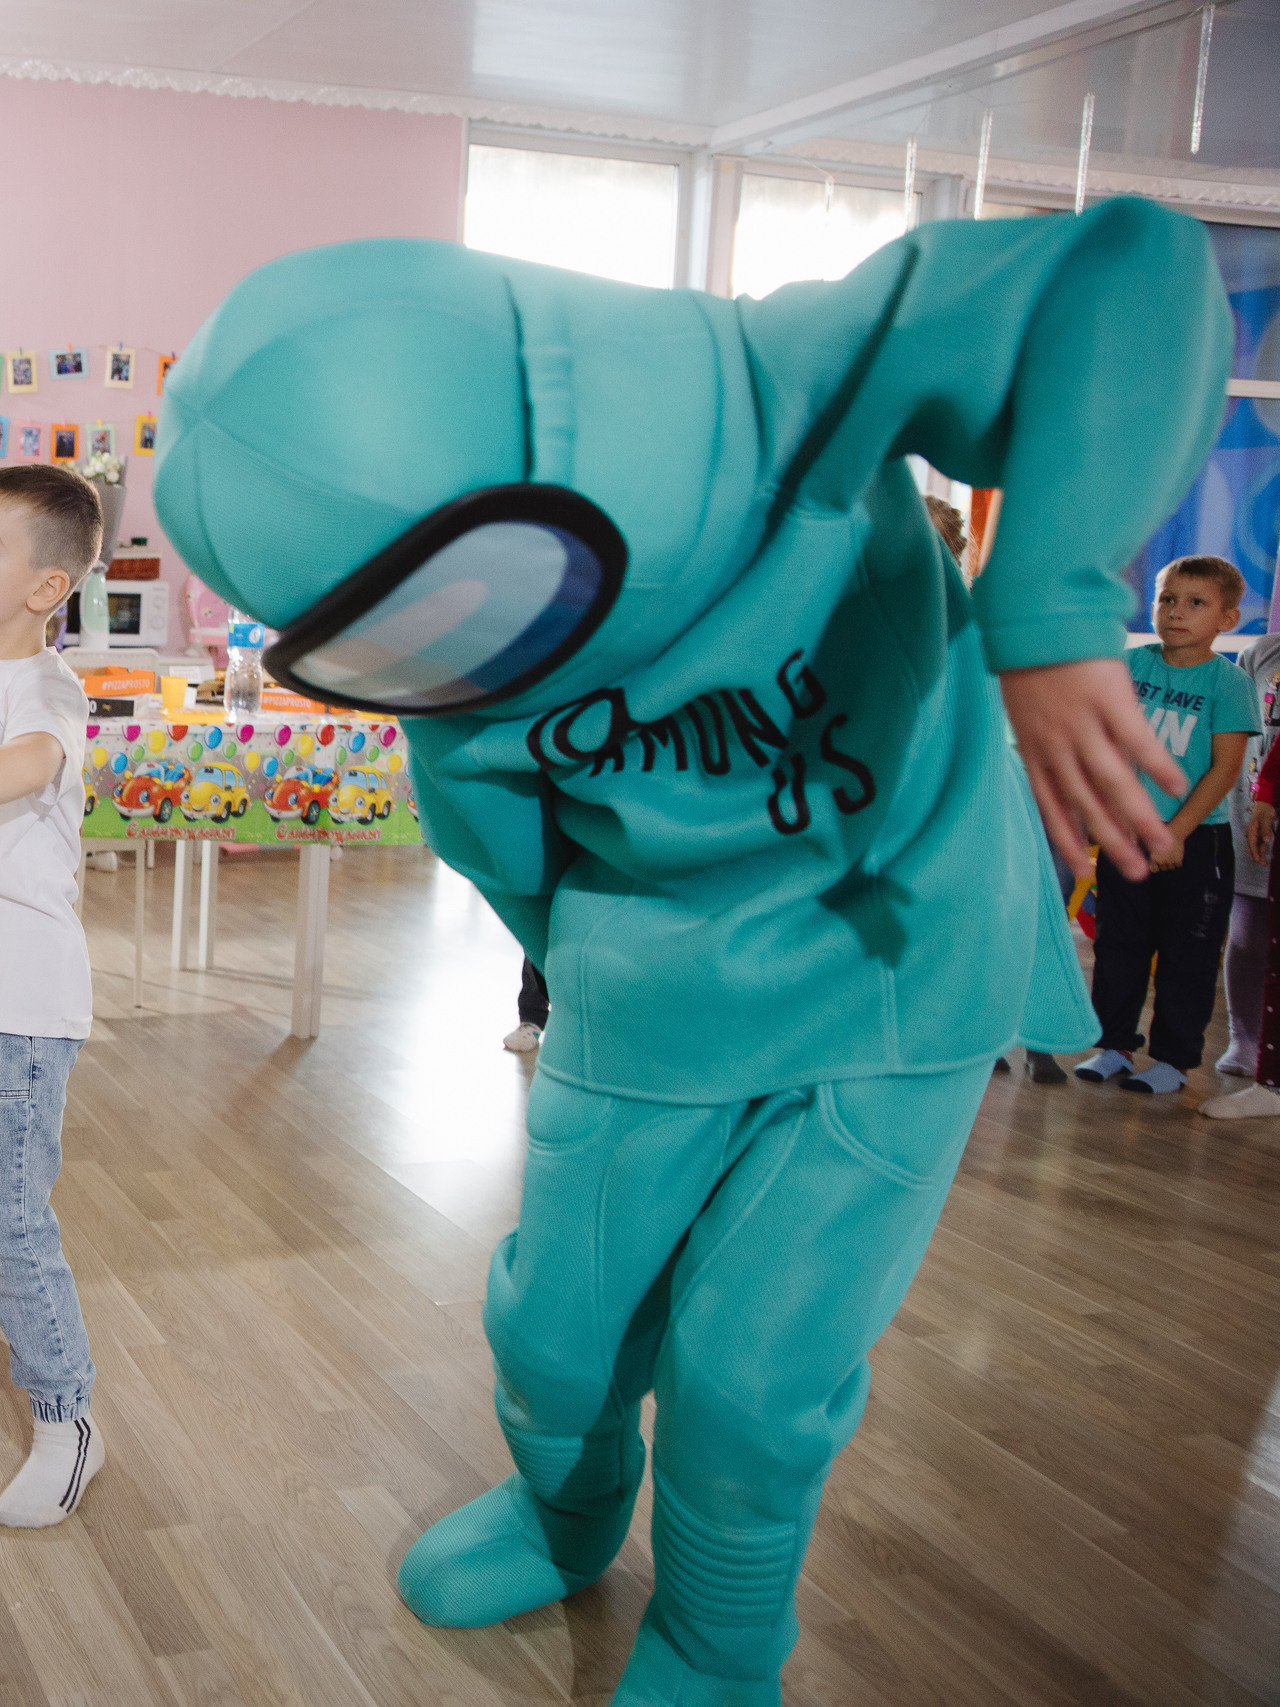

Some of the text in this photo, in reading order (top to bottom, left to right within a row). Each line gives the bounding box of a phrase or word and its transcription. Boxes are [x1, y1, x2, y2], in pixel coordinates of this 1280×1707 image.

[102, 678, 150, 691] #PIZZAPROSTO
[1131, 680, 1206, 711] UST HAVE
[264, 696, 312, 709] #PIZZAPROSTO
[1137, 702, 1198, 757] UN
[767, 713, 876, 836] US
